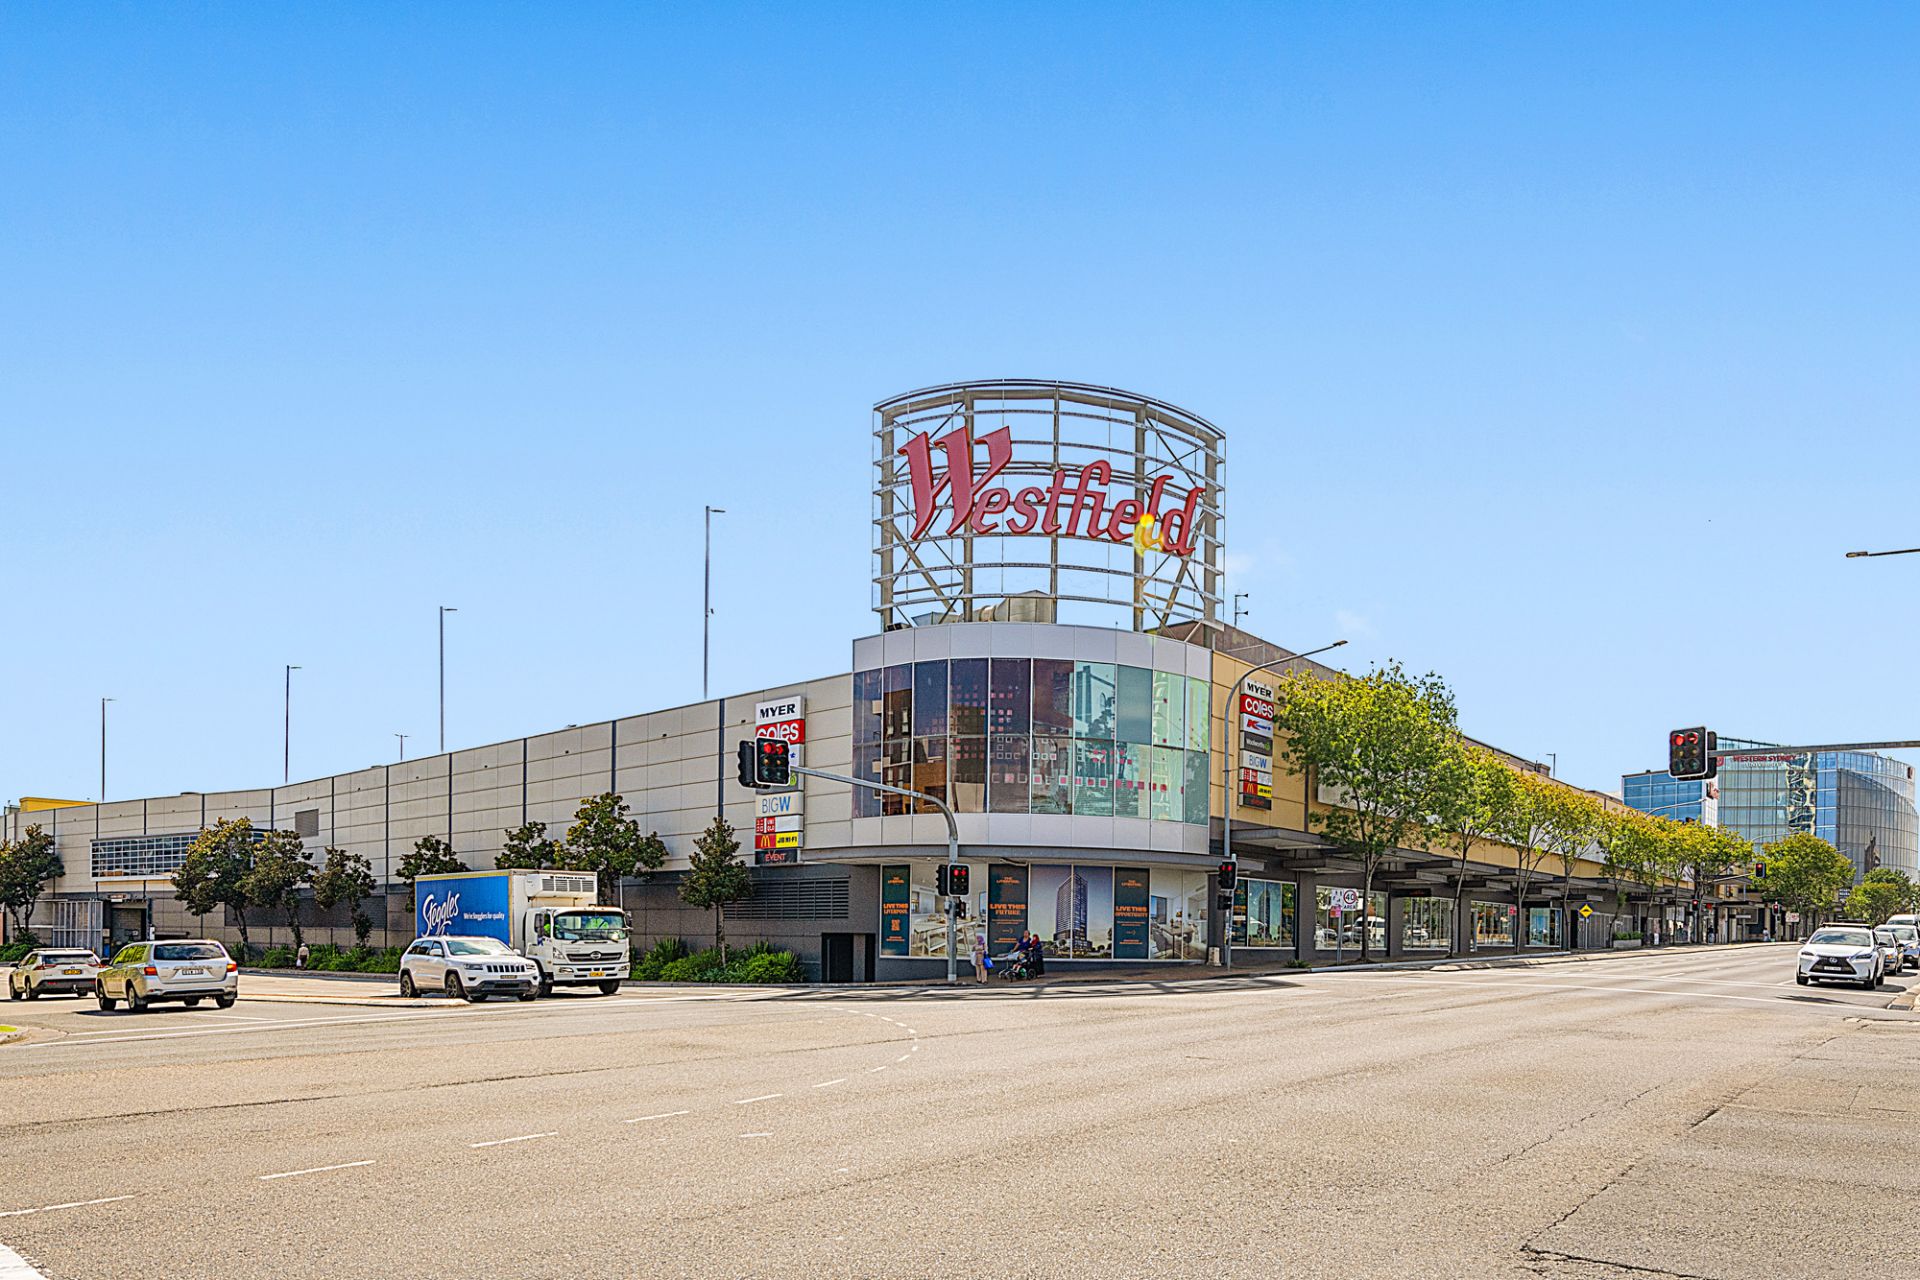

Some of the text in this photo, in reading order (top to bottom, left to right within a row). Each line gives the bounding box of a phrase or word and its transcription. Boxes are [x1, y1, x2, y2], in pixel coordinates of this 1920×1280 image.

[897, 425, 1206, 557] Westfield
[1247, 682, 1272, 698] MYER
[760, 703, 796, 718] MYER
[1245, 698, 1274, 718] coles
[421, 890, 460, 937] Steggles
